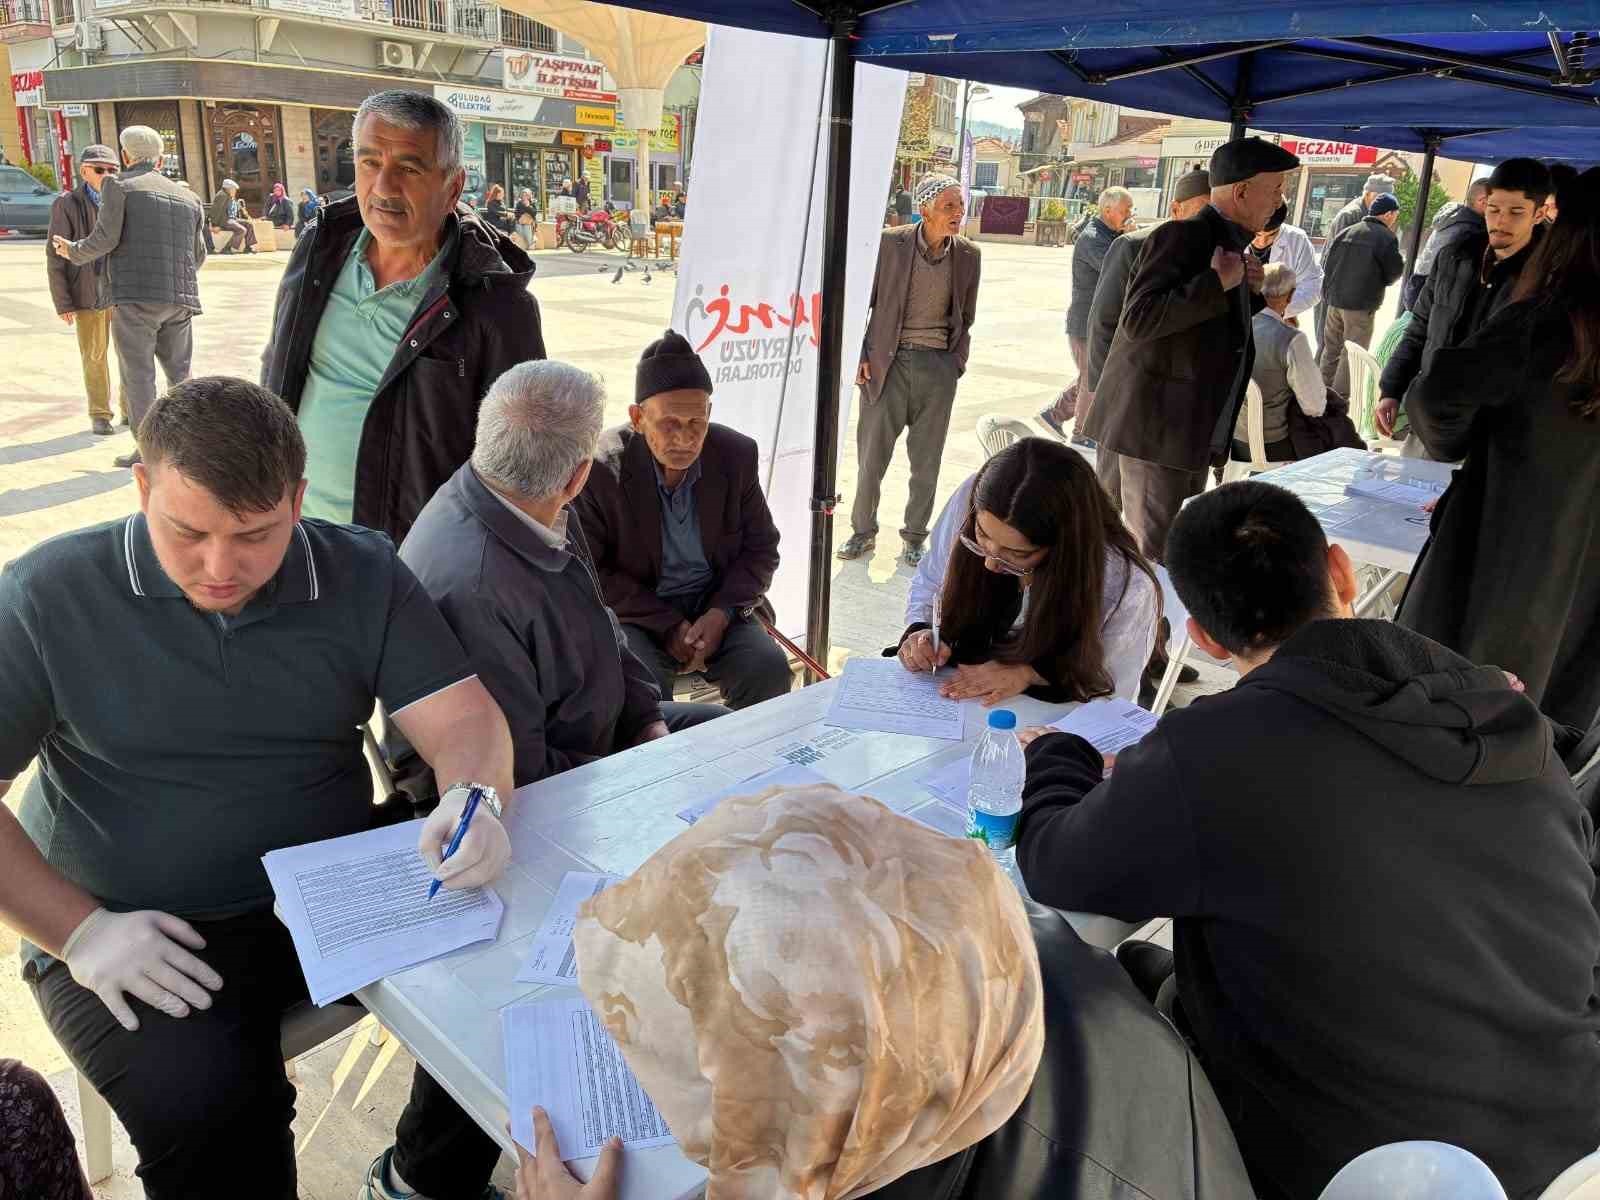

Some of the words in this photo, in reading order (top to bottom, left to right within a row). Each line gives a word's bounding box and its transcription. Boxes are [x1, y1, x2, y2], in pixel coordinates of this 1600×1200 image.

[532, 56, 602, 75] TAŞPINAR
[457, 93, 491, 103] ULUDAĞ
[1297, 142, 1353, 155] ECZANE
